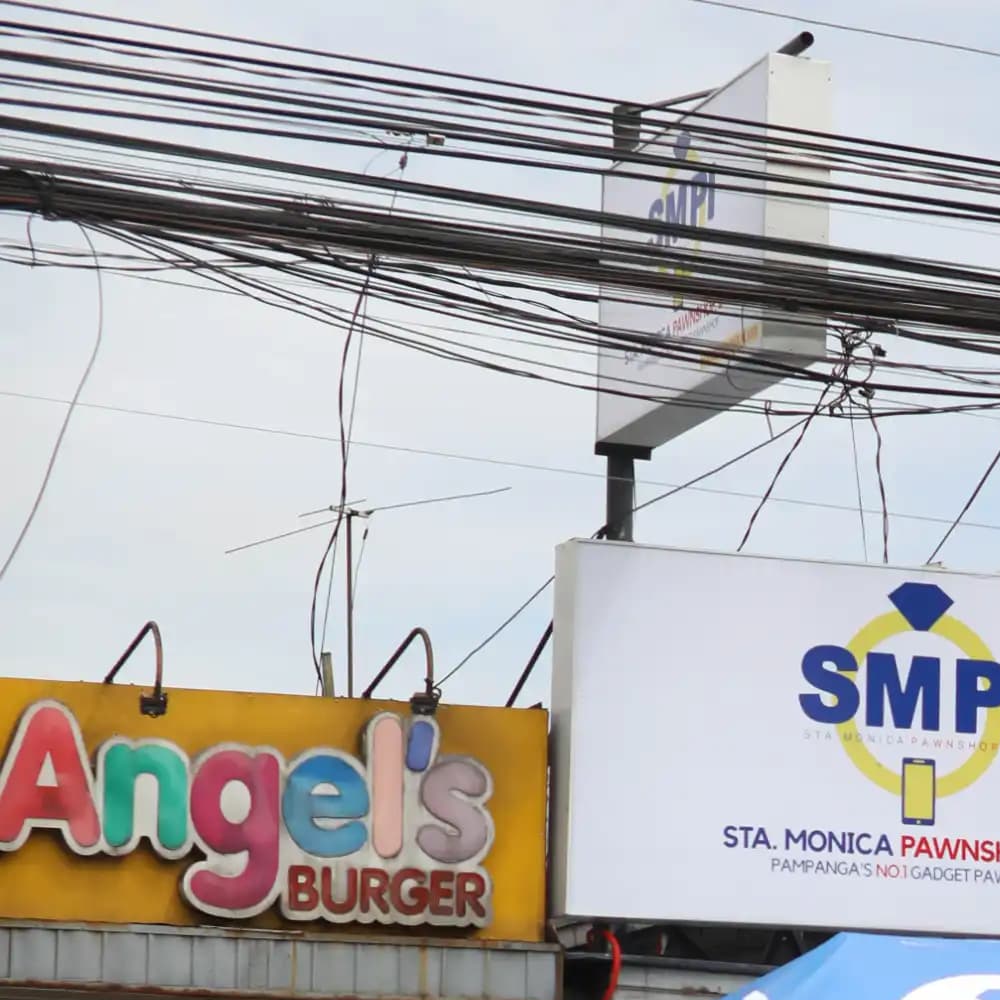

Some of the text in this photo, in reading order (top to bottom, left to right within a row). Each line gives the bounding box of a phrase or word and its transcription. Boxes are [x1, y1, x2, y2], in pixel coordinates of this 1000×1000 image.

[0, 702, 491, 913] Angel's
[723, 825, 777, 850] STA.
[785, 829, 893, 856] MONICA
[287, 864, 487, 919] BURGER
[771, 858, 873, 878] PAMPANGA'S
[876, 863, 907, 879] NO.1
[911, 866, 971, 883] GADGET
